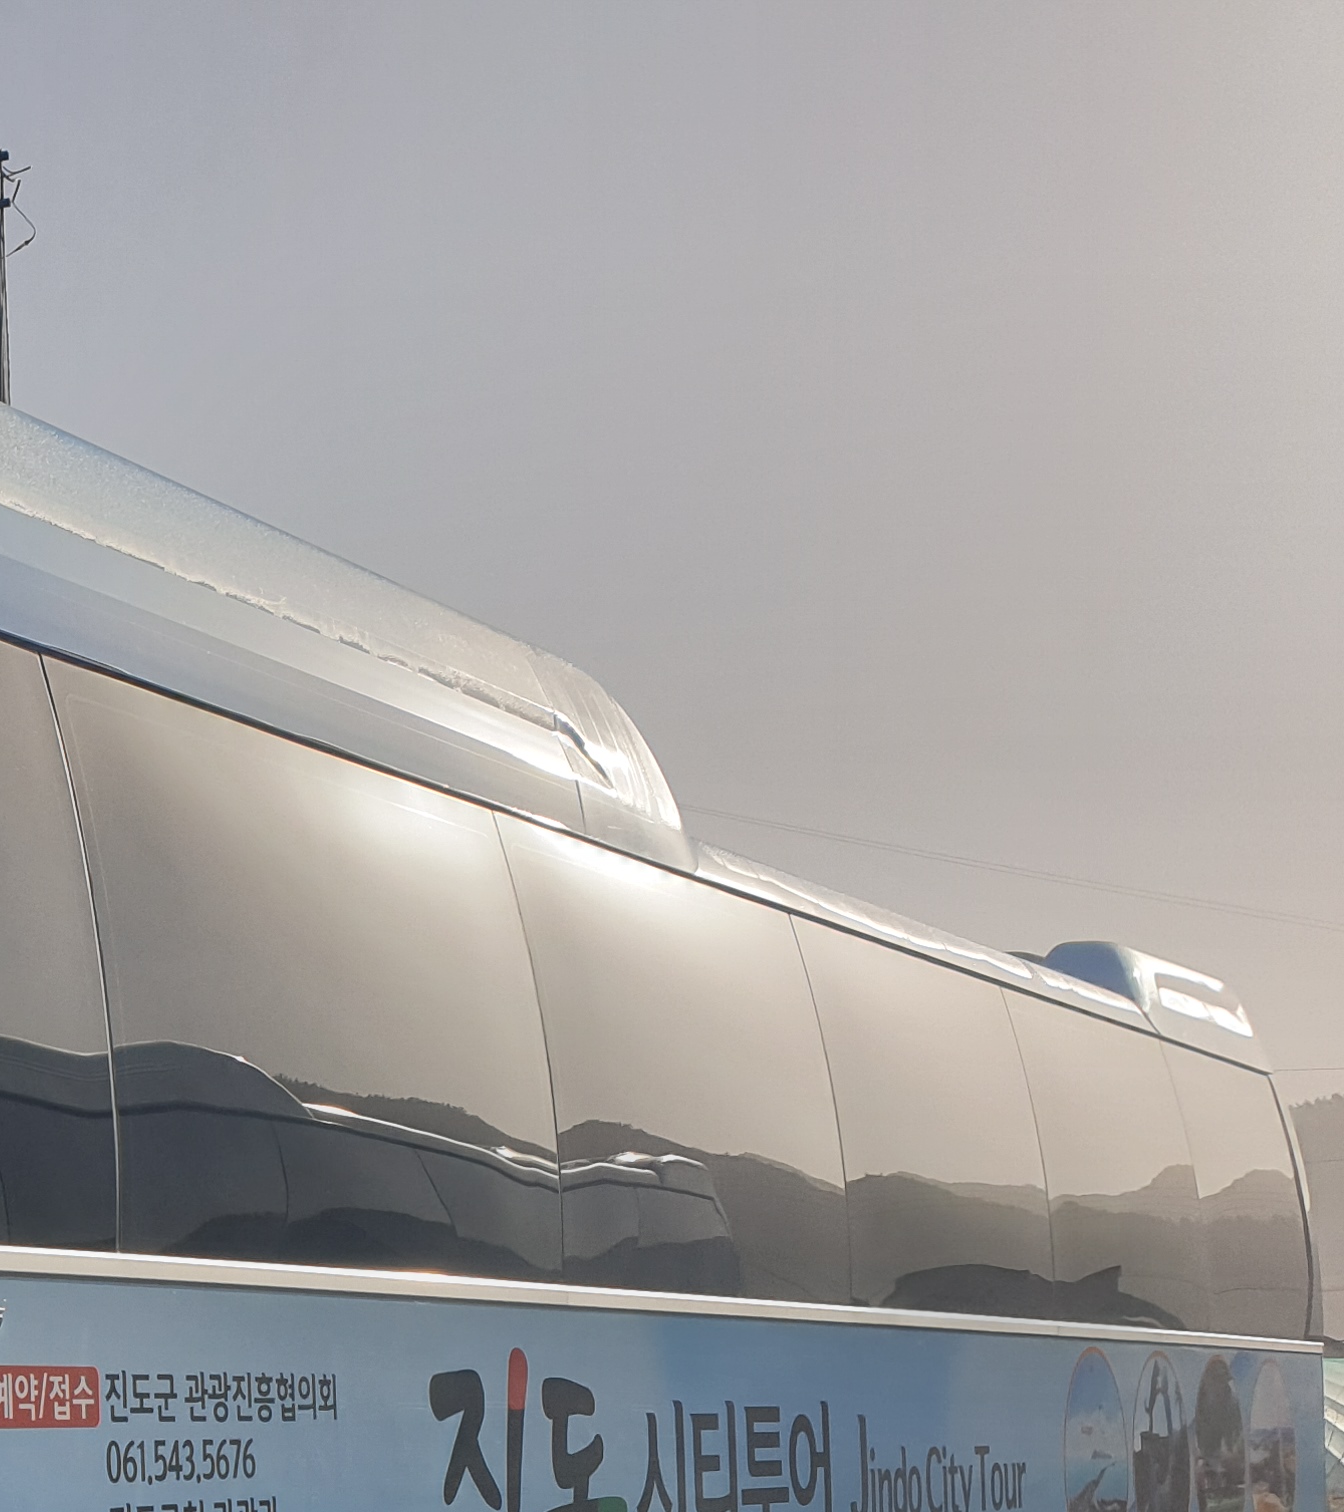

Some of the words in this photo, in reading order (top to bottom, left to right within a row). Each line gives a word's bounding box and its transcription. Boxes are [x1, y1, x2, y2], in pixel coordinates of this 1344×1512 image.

[105, 1370, 178, 1423] 진도군
[184, 1371, 338, 1423] 관광진흥협의회
[106, 1438, 256, 1485] 061.543.5676
[974, 1445, 1027, 1512] Tour
